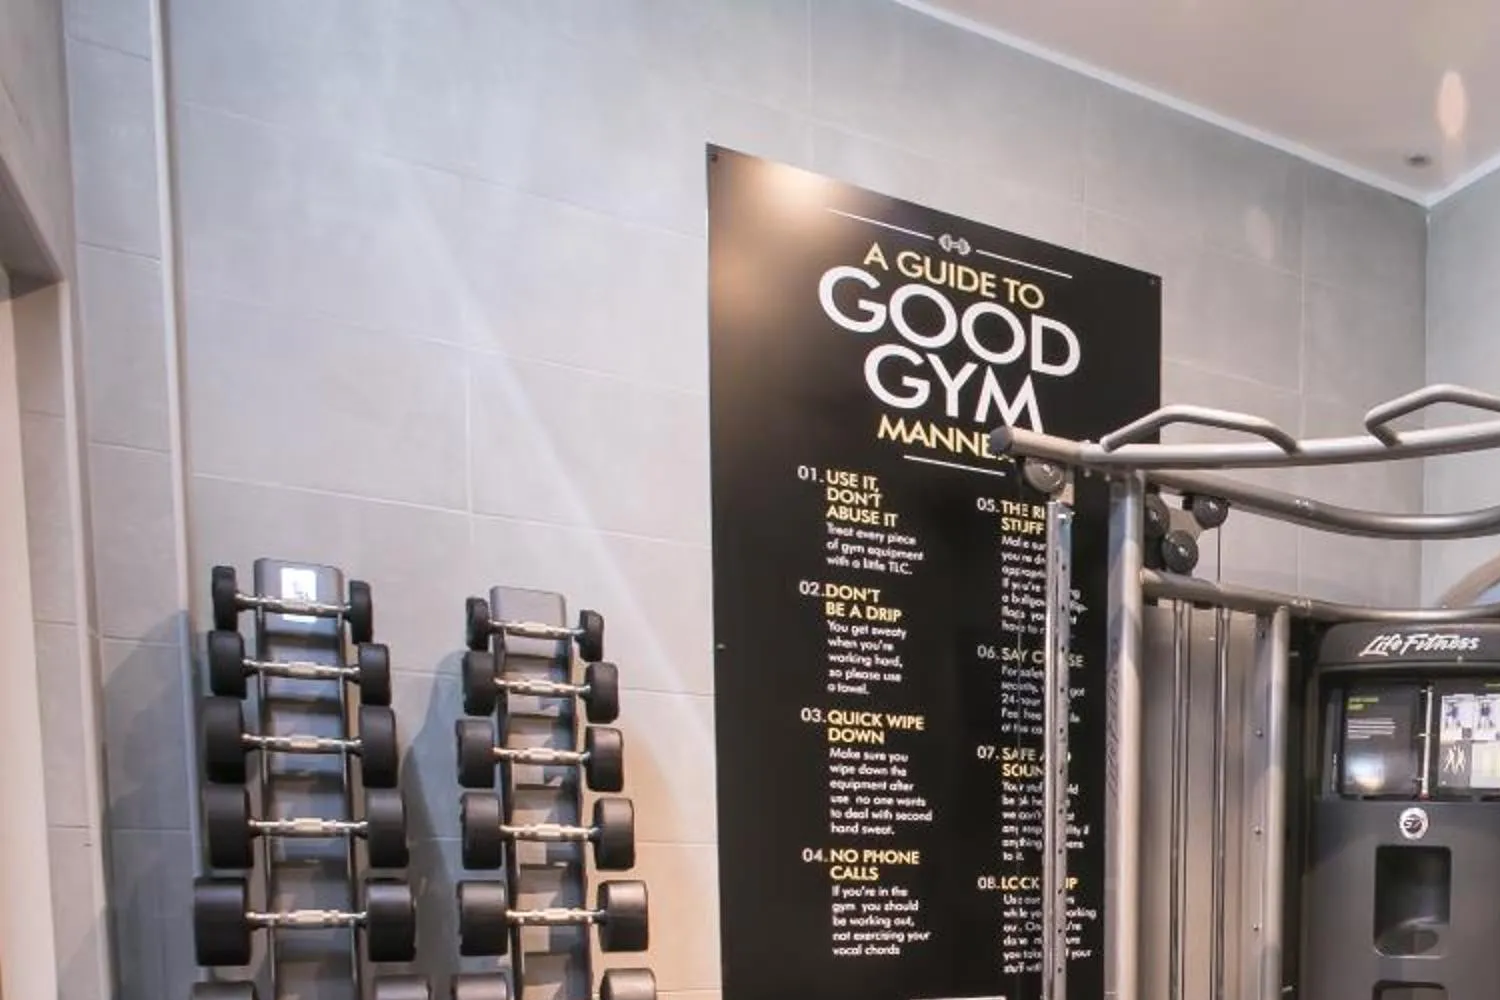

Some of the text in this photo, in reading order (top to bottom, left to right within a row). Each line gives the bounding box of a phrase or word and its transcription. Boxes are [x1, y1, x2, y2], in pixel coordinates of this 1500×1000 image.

[864, 243, 1044, 310] A GUIDE TO
[819, 266, 1080, 377] GOOD
[864, 344, 1043, 434] GYM
[877, 413, 1015, 463] MANNE
[798, 465, 824, 483] 01.
[826, 469, 858, 488] USE
[826, 487, 882, 508] DON'T
[826, 504, 898, 527] ABUSE IT
[976, 497, 1000, 513] 05.
[1000, 500, 1029, 517] THE
[826, 521, 854, 536] Treat
[841, 543, 865, 555] gym
[867, 547, 924, 561] equipment
[799, 580, 881, 603] 02. DON'T
[825, 601, 903, 622] BE A DRIP
[827, 619, 907, 640] You get sweaty
[827, 636, 858, 649] when
[1399, 632, 1480, 656] Fitness
[828, 652, 872, 667] working
[977, 645, 999, 660] 06.
[1001, 647, 1028, 663] SAY
[845, 667, 881, 681] please
[800, 707, 925, 731] 03. QUICK WIPE
[828, 727, 885, 744] DOWN
[829, 747, 909, 764] Make sure you
[977, 745, 999, 760] 07.
[1001, 747, 1036, 761] SAFE
[829, 763, 907, 777] wipe down the
[1002, 763, 1043, 777] SOUN
[829, 778, 914, 791] equipment after
[855, 796, 871, 805] no
[873, 797, 894, 805] one
[896, 796, 927, 807] wants
[830, 807, 933, 822] to deal with second
[830, 821, 859, 834] hand
[802, 847, 920, 865] 04. NO PHONE
[829, 865, 880, 881] CALLS
[841, 885, 876, 899] you're
[878, 886, 889, 897] in
[861, 903, 881, 913] you
[883, 900, 919, 911] should
[832, 915, 846, 927] be
[849, 914, 891, 928] working
[832, 930, 931, 943] not exercising your
[832, 943, 862, 956] vocal
